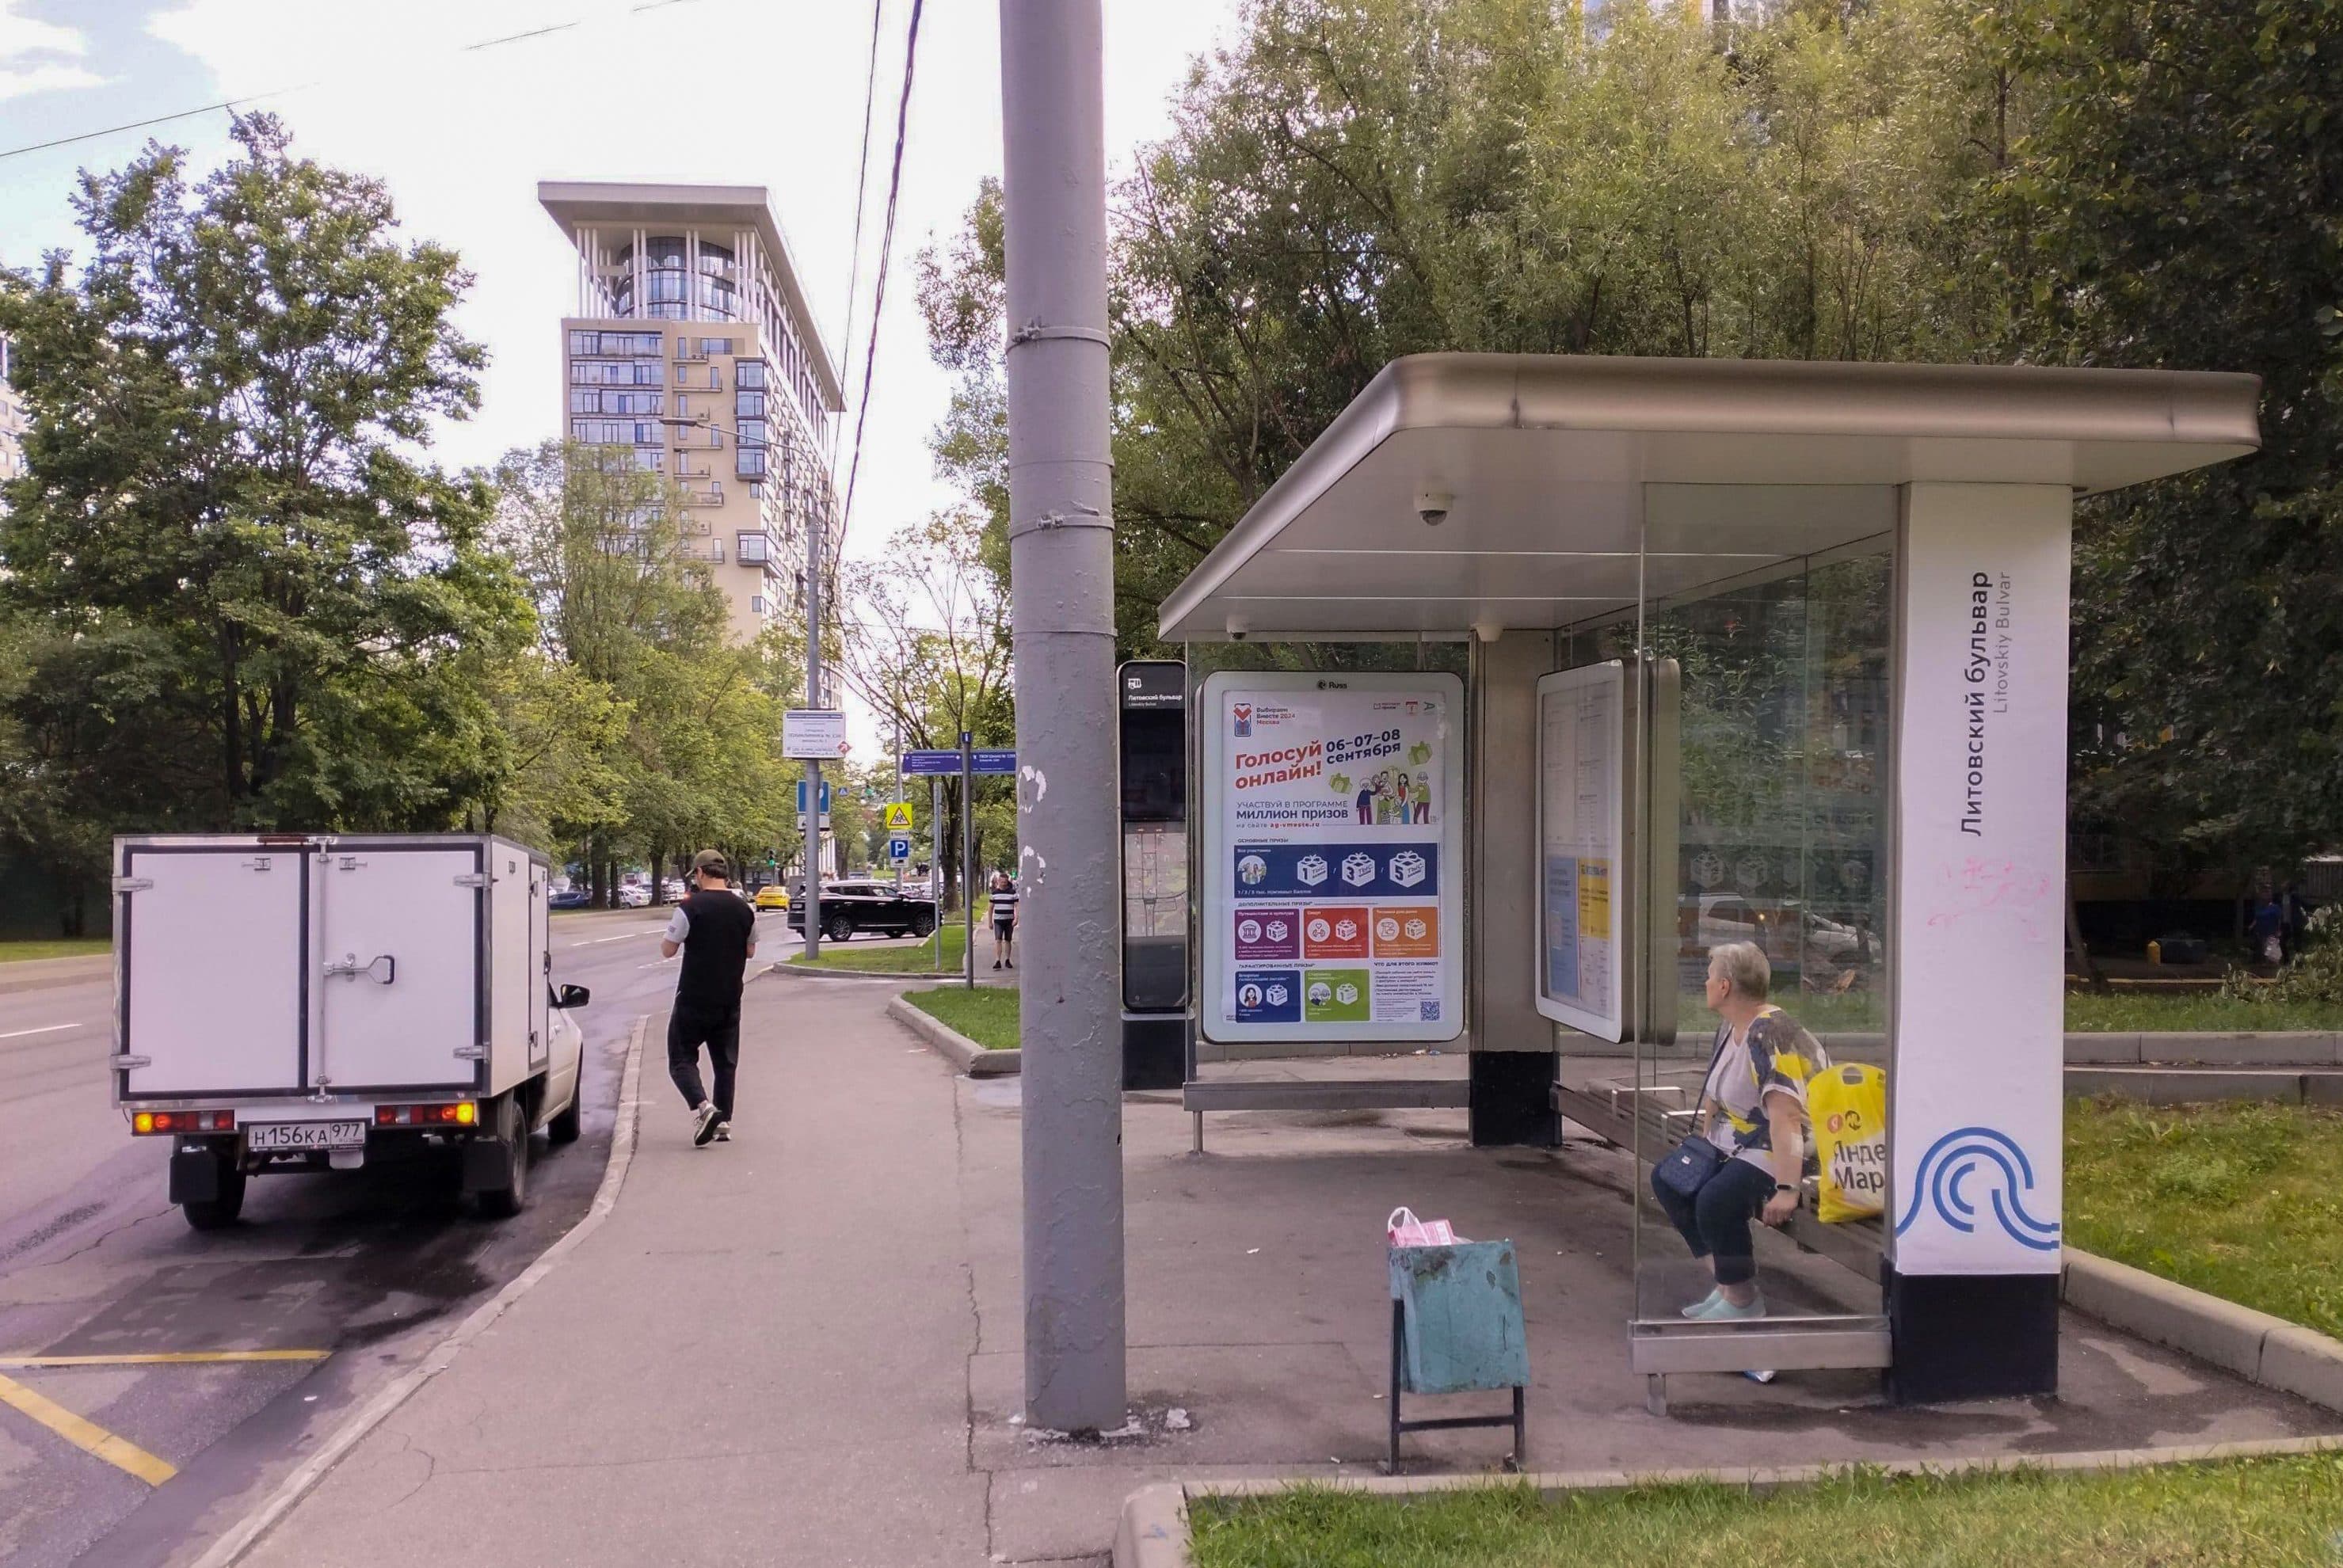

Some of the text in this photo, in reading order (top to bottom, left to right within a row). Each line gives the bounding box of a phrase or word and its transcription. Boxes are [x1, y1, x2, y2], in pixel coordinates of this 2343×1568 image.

[1994, 572, 2013, 713] Litovskiy Bulvar
[1961, 572, 1993, 836] Литовский бульвар
[1326, 729, 1400, 752] 06-07-08
[1236, 740, 1322, 770] Голосуй
[1327, 742, 1401, 764] сентября
[1235, 760, 1322, 790] онлайн!
[1236, 809, 1348, 820] миллион призов
[894, 841, 906, 856] P
[1303, 867, 1308, 881] 1
[1347, 866, 1354, 881] 3
[1395, 865, 1404, 881] 5
[1268, 928, 1277, 938] 15
[1337, 927, 1346, 937] 15
[332, 1123, 360, 1137] 977
